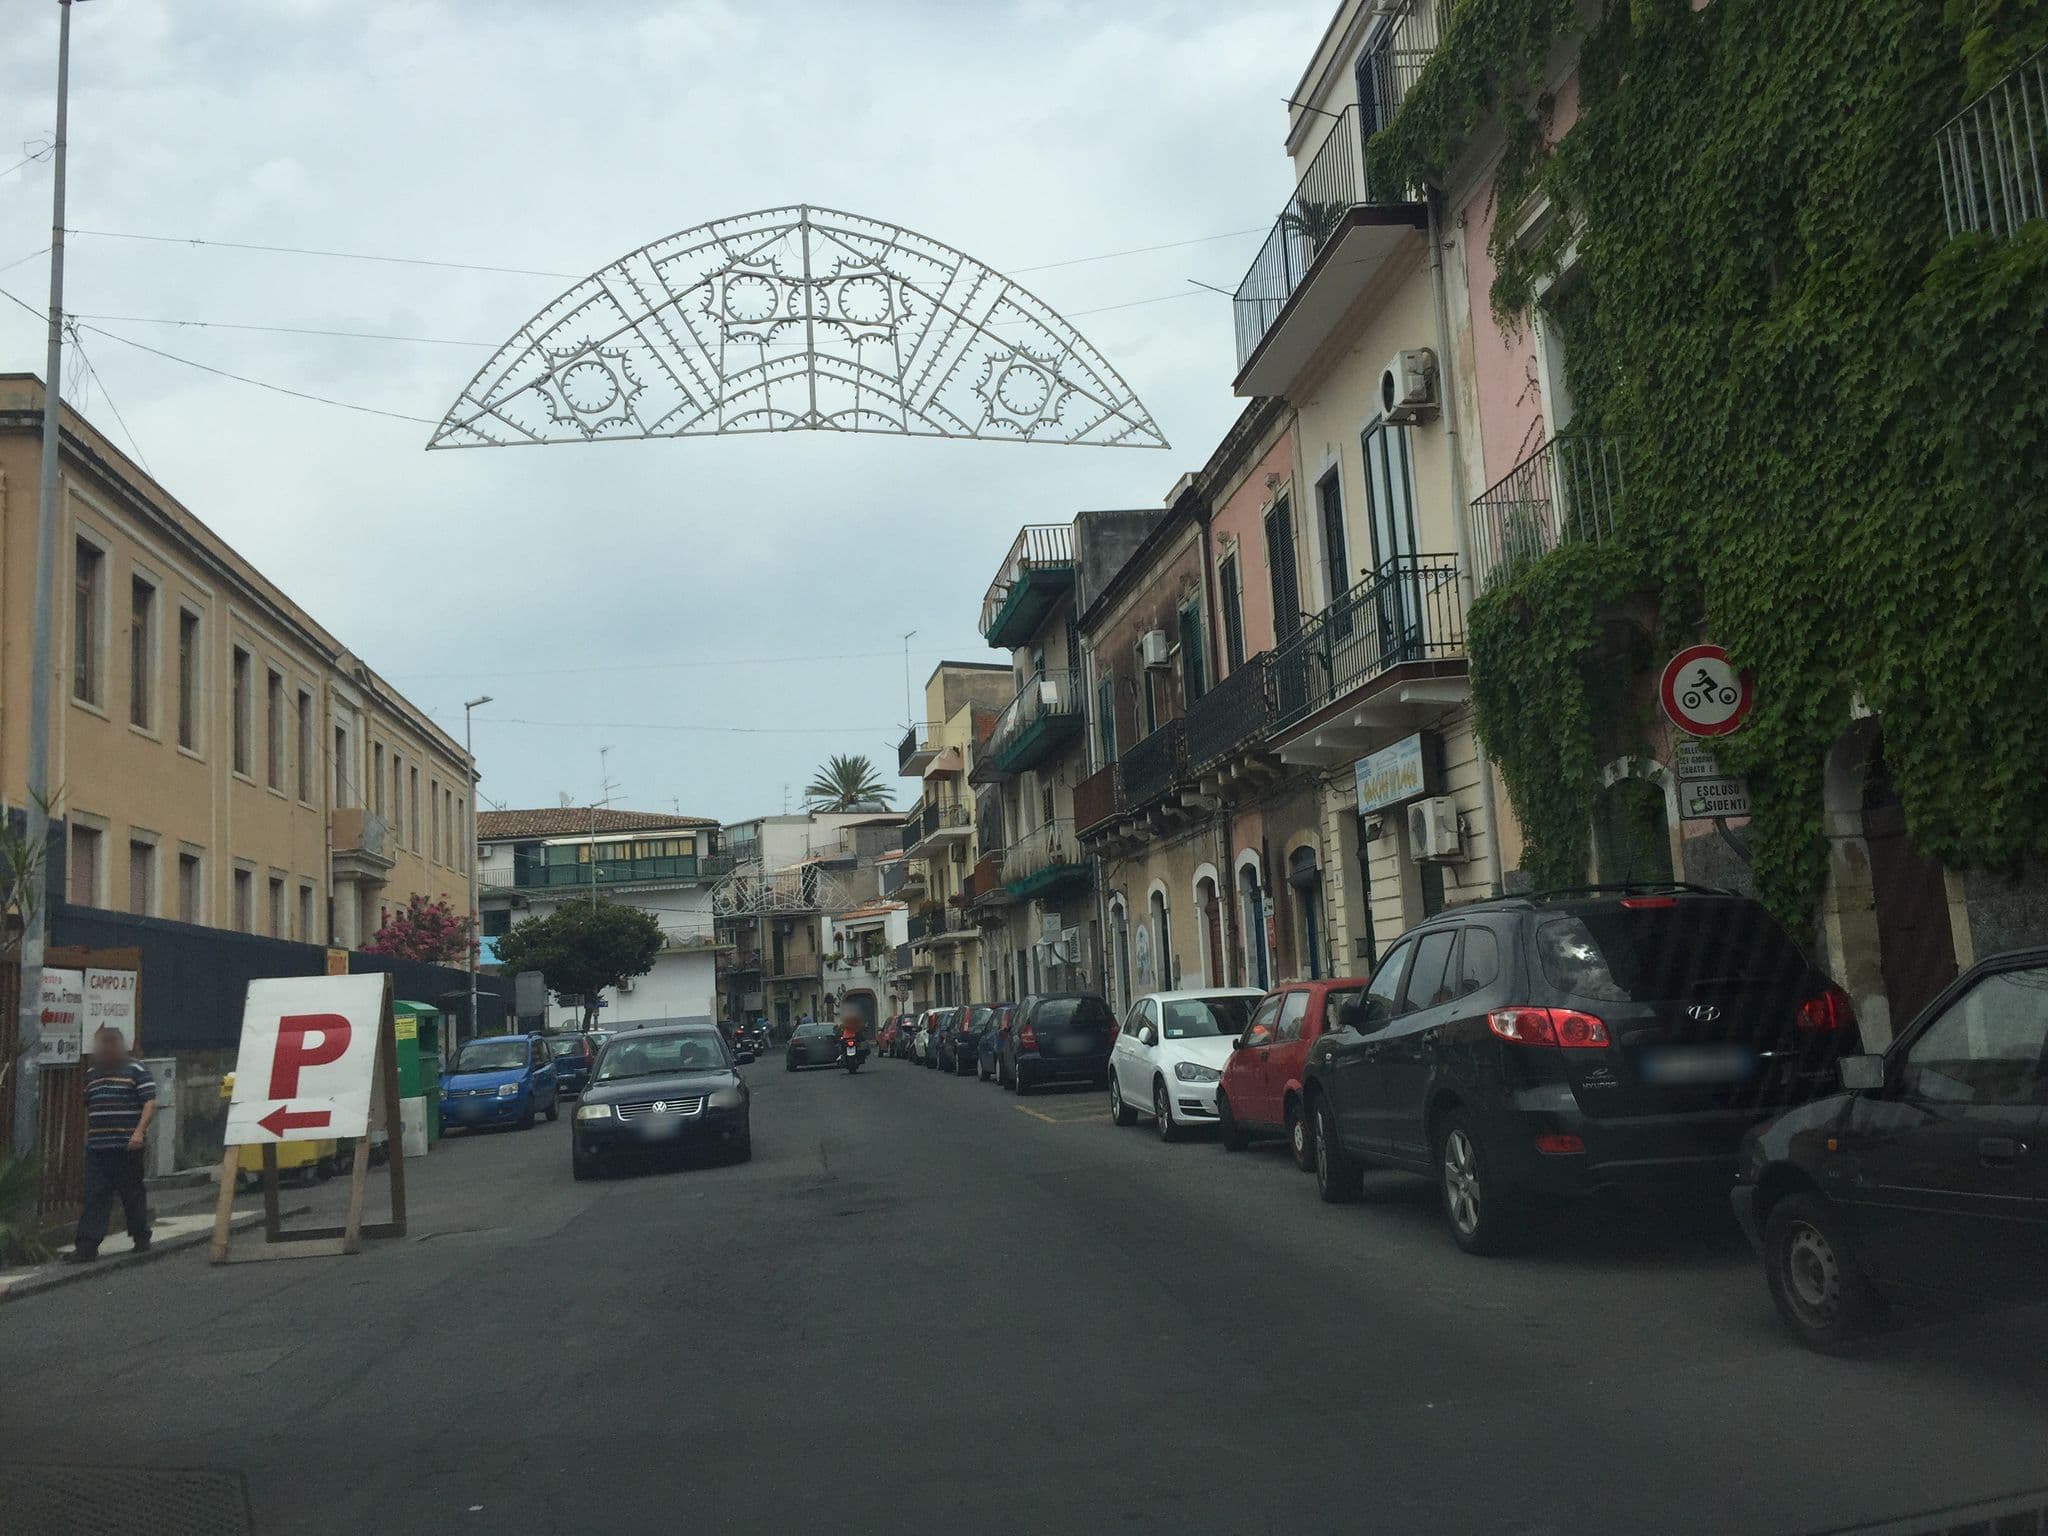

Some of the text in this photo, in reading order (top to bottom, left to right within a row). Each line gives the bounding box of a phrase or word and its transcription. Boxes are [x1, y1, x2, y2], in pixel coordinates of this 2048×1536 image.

[1696, 784, 1740, 796] ESCLUSO
[1704, 798, 1746, 812] SIDENTI
[90, 975, 135, 991] CAMPO A 7
[268, 1013, 352, 1100] P
